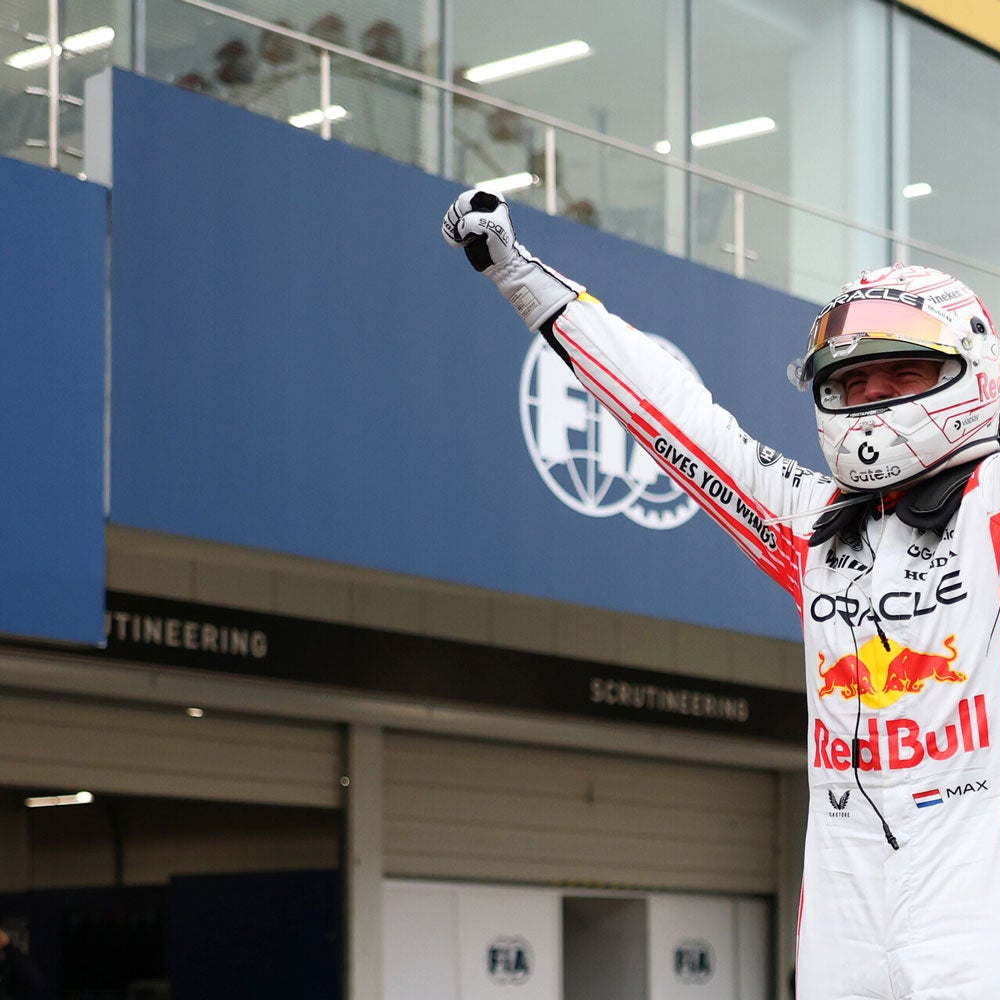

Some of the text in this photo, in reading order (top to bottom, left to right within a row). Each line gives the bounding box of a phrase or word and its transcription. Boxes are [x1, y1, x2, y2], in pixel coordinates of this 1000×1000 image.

[654, 438, 698, 479] GIVES
[700, 471, 733, 505] YOU
[735, 498, 777, 549] WINGS
[849, 465, 901, 483] Gate.io
[811, 570, 968, 627] ORACLE
[813, 694, 991, 771] Red Bull
[946, 780, 988, 798] MAX
